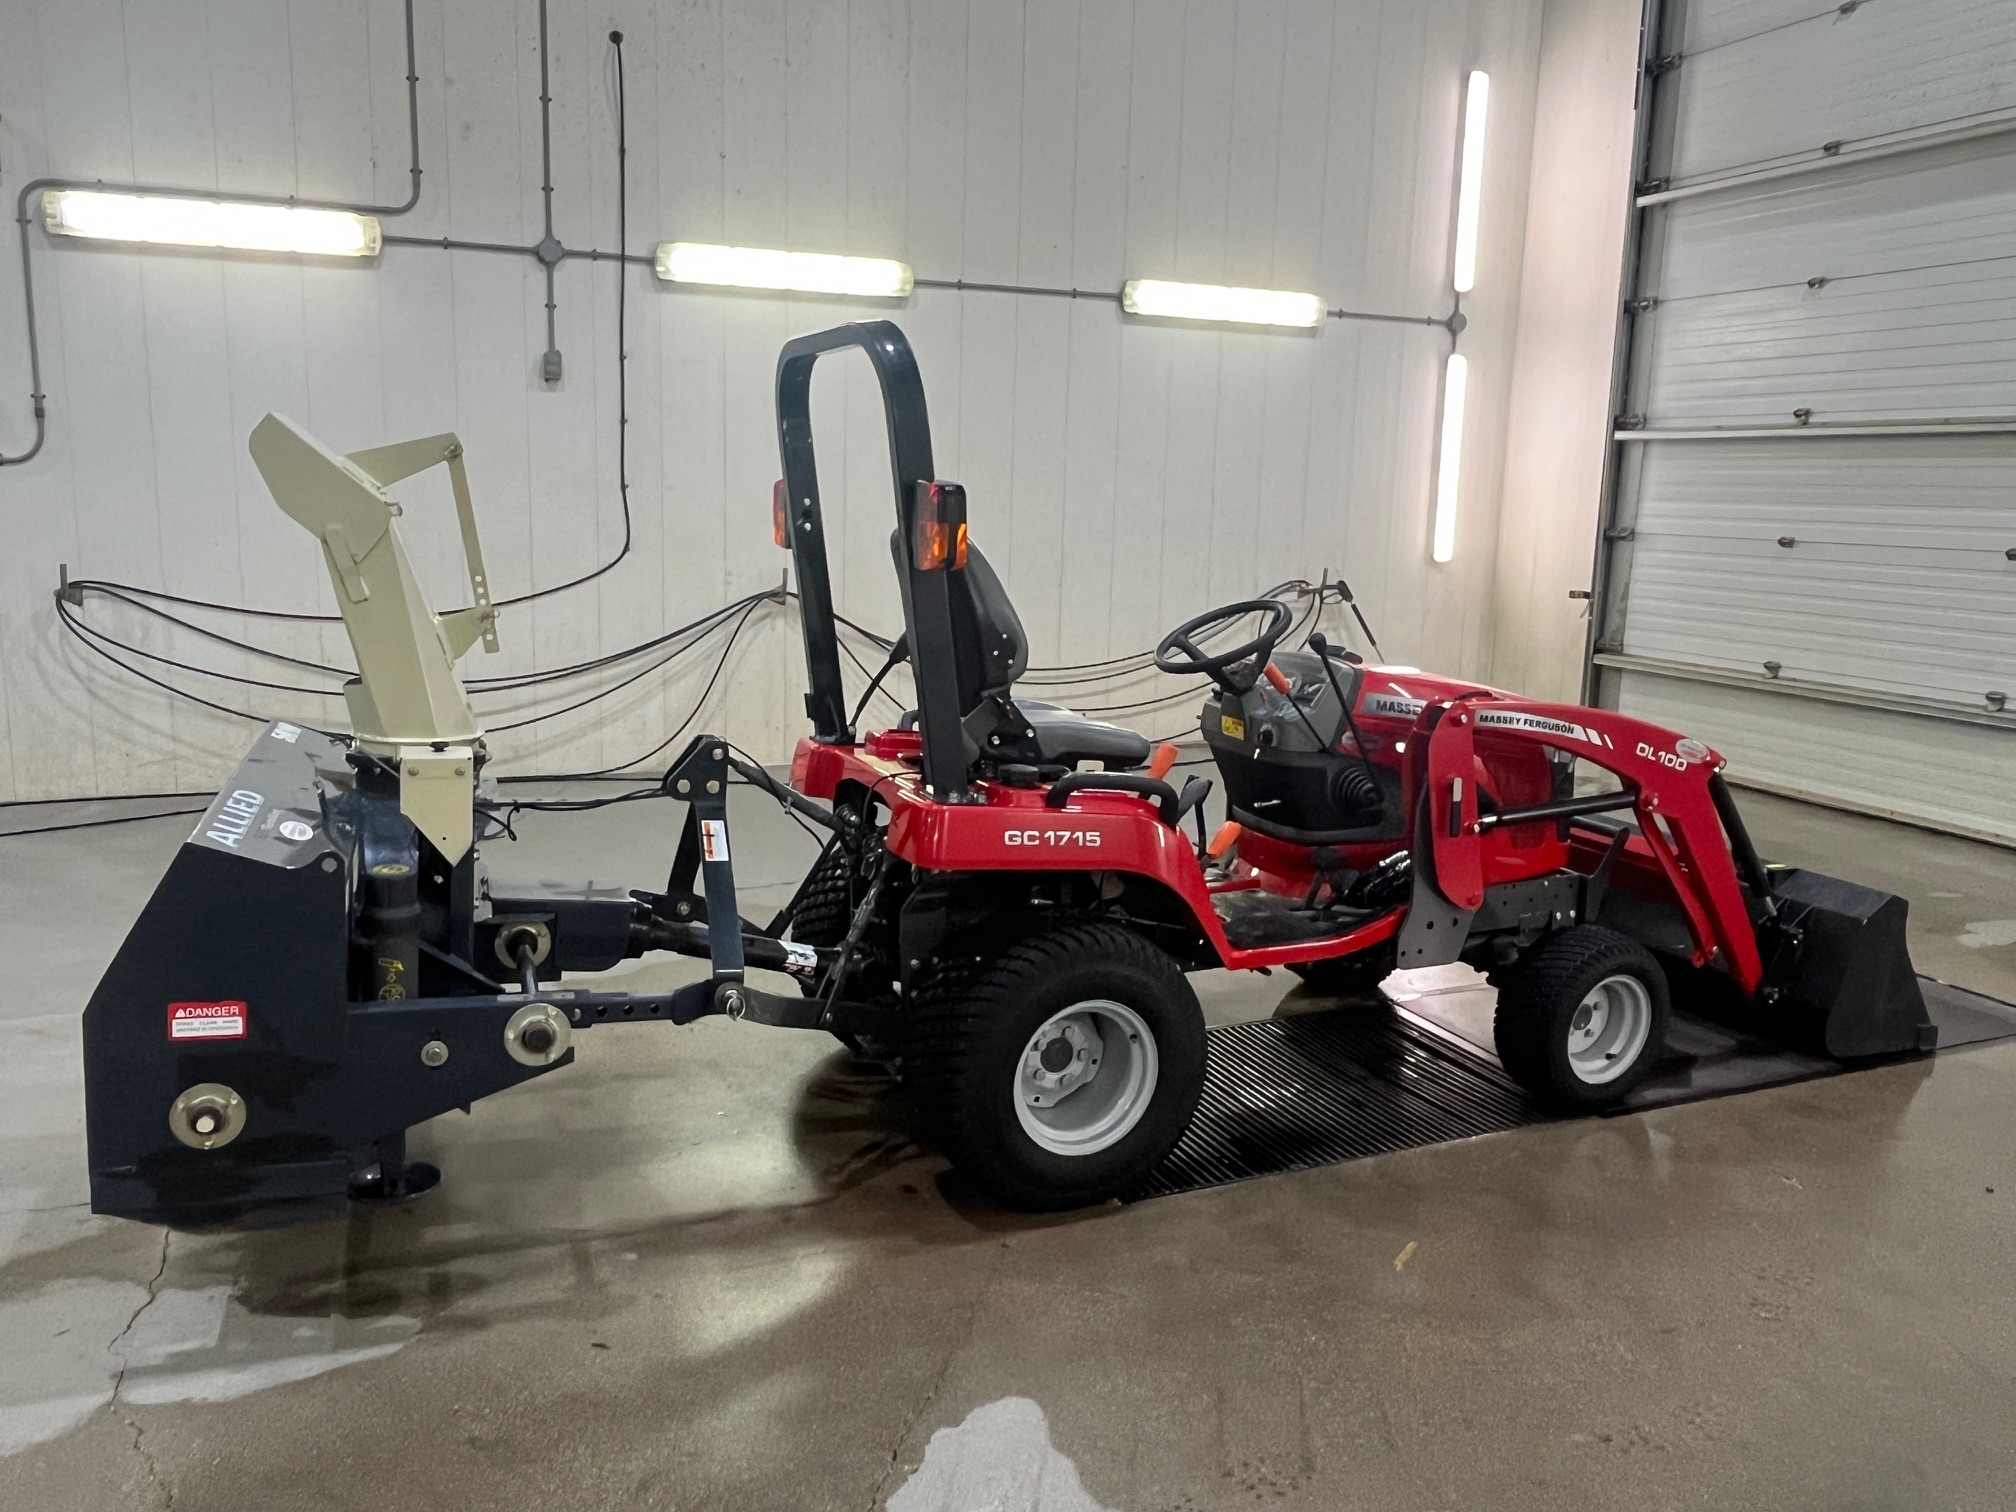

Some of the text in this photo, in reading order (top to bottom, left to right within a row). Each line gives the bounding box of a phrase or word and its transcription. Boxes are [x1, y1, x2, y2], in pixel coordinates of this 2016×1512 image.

[1376, 700, 1424, 716] MASSE
[1479, 714, 1575, 735] MASSEY FERGUSON
[206, 790, 265, 848] ALLIED
[1004, 830, 1101, 847] GC 1715
[185, 1006, 239, 1018] DANGER
